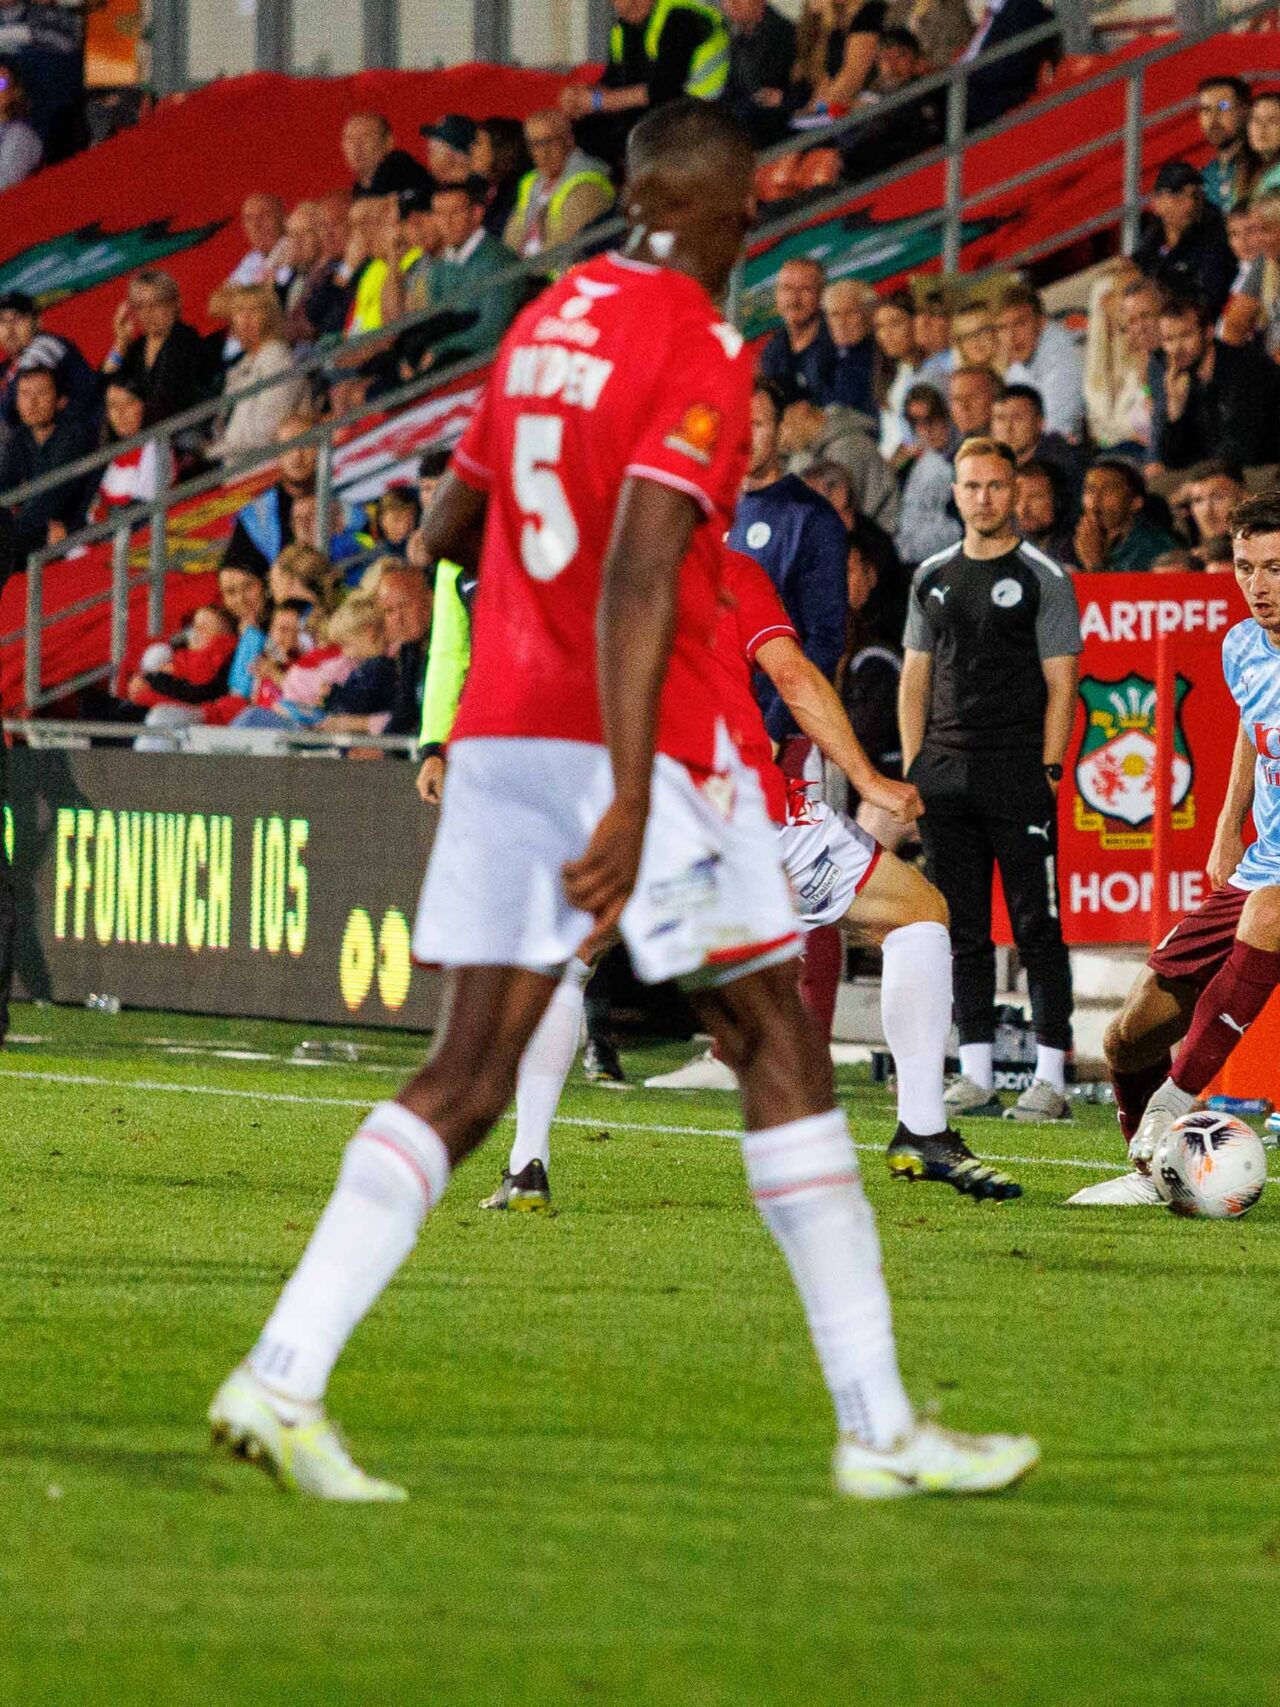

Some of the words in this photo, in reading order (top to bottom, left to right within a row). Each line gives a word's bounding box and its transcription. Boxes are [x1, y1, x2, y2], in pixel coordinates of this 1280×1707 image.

[513, 414, 579, 581] 5
[55, 808, 232, 949] FFONIWCH
[251, 814, 308, 955] 105
[812, 866, 840, 903] Trailers
